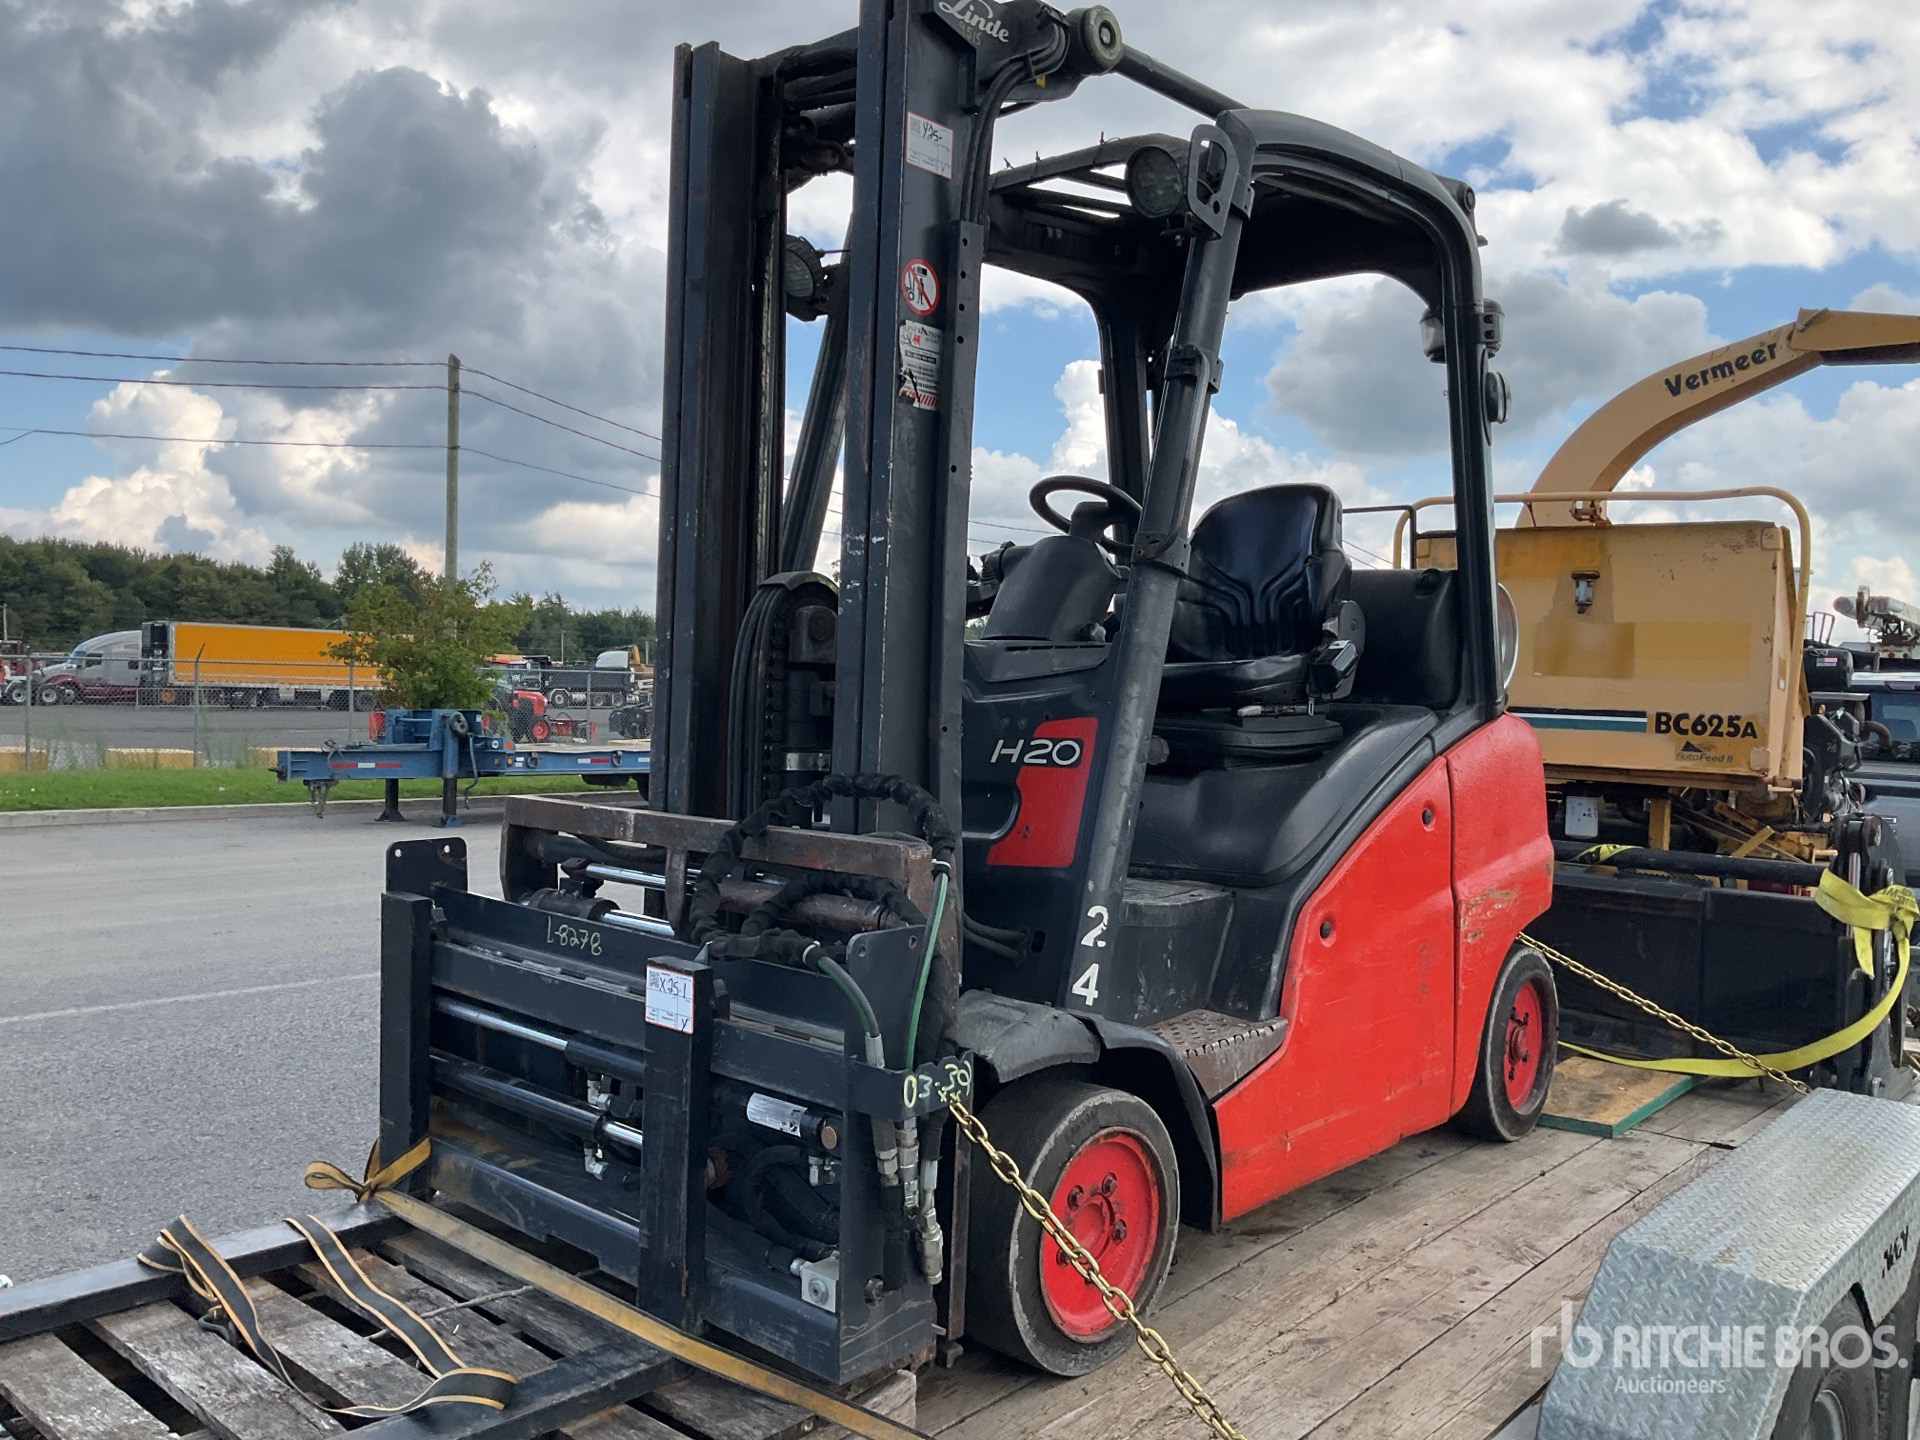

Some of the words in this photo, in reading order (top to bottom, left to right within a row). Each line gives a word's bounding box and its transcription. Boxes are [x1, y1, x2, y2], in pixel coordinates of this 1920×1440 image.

[938, 0, 1009, 42] Linde
[1664, 342, 1777, 397] Vermeer
[1655, 711, 1758, 739] BC625A
[990, 739, 1081, 766] H20
[1675, 752, 1726, 763] AutoFeed
[1071, 963, 1099, 1006] 4
